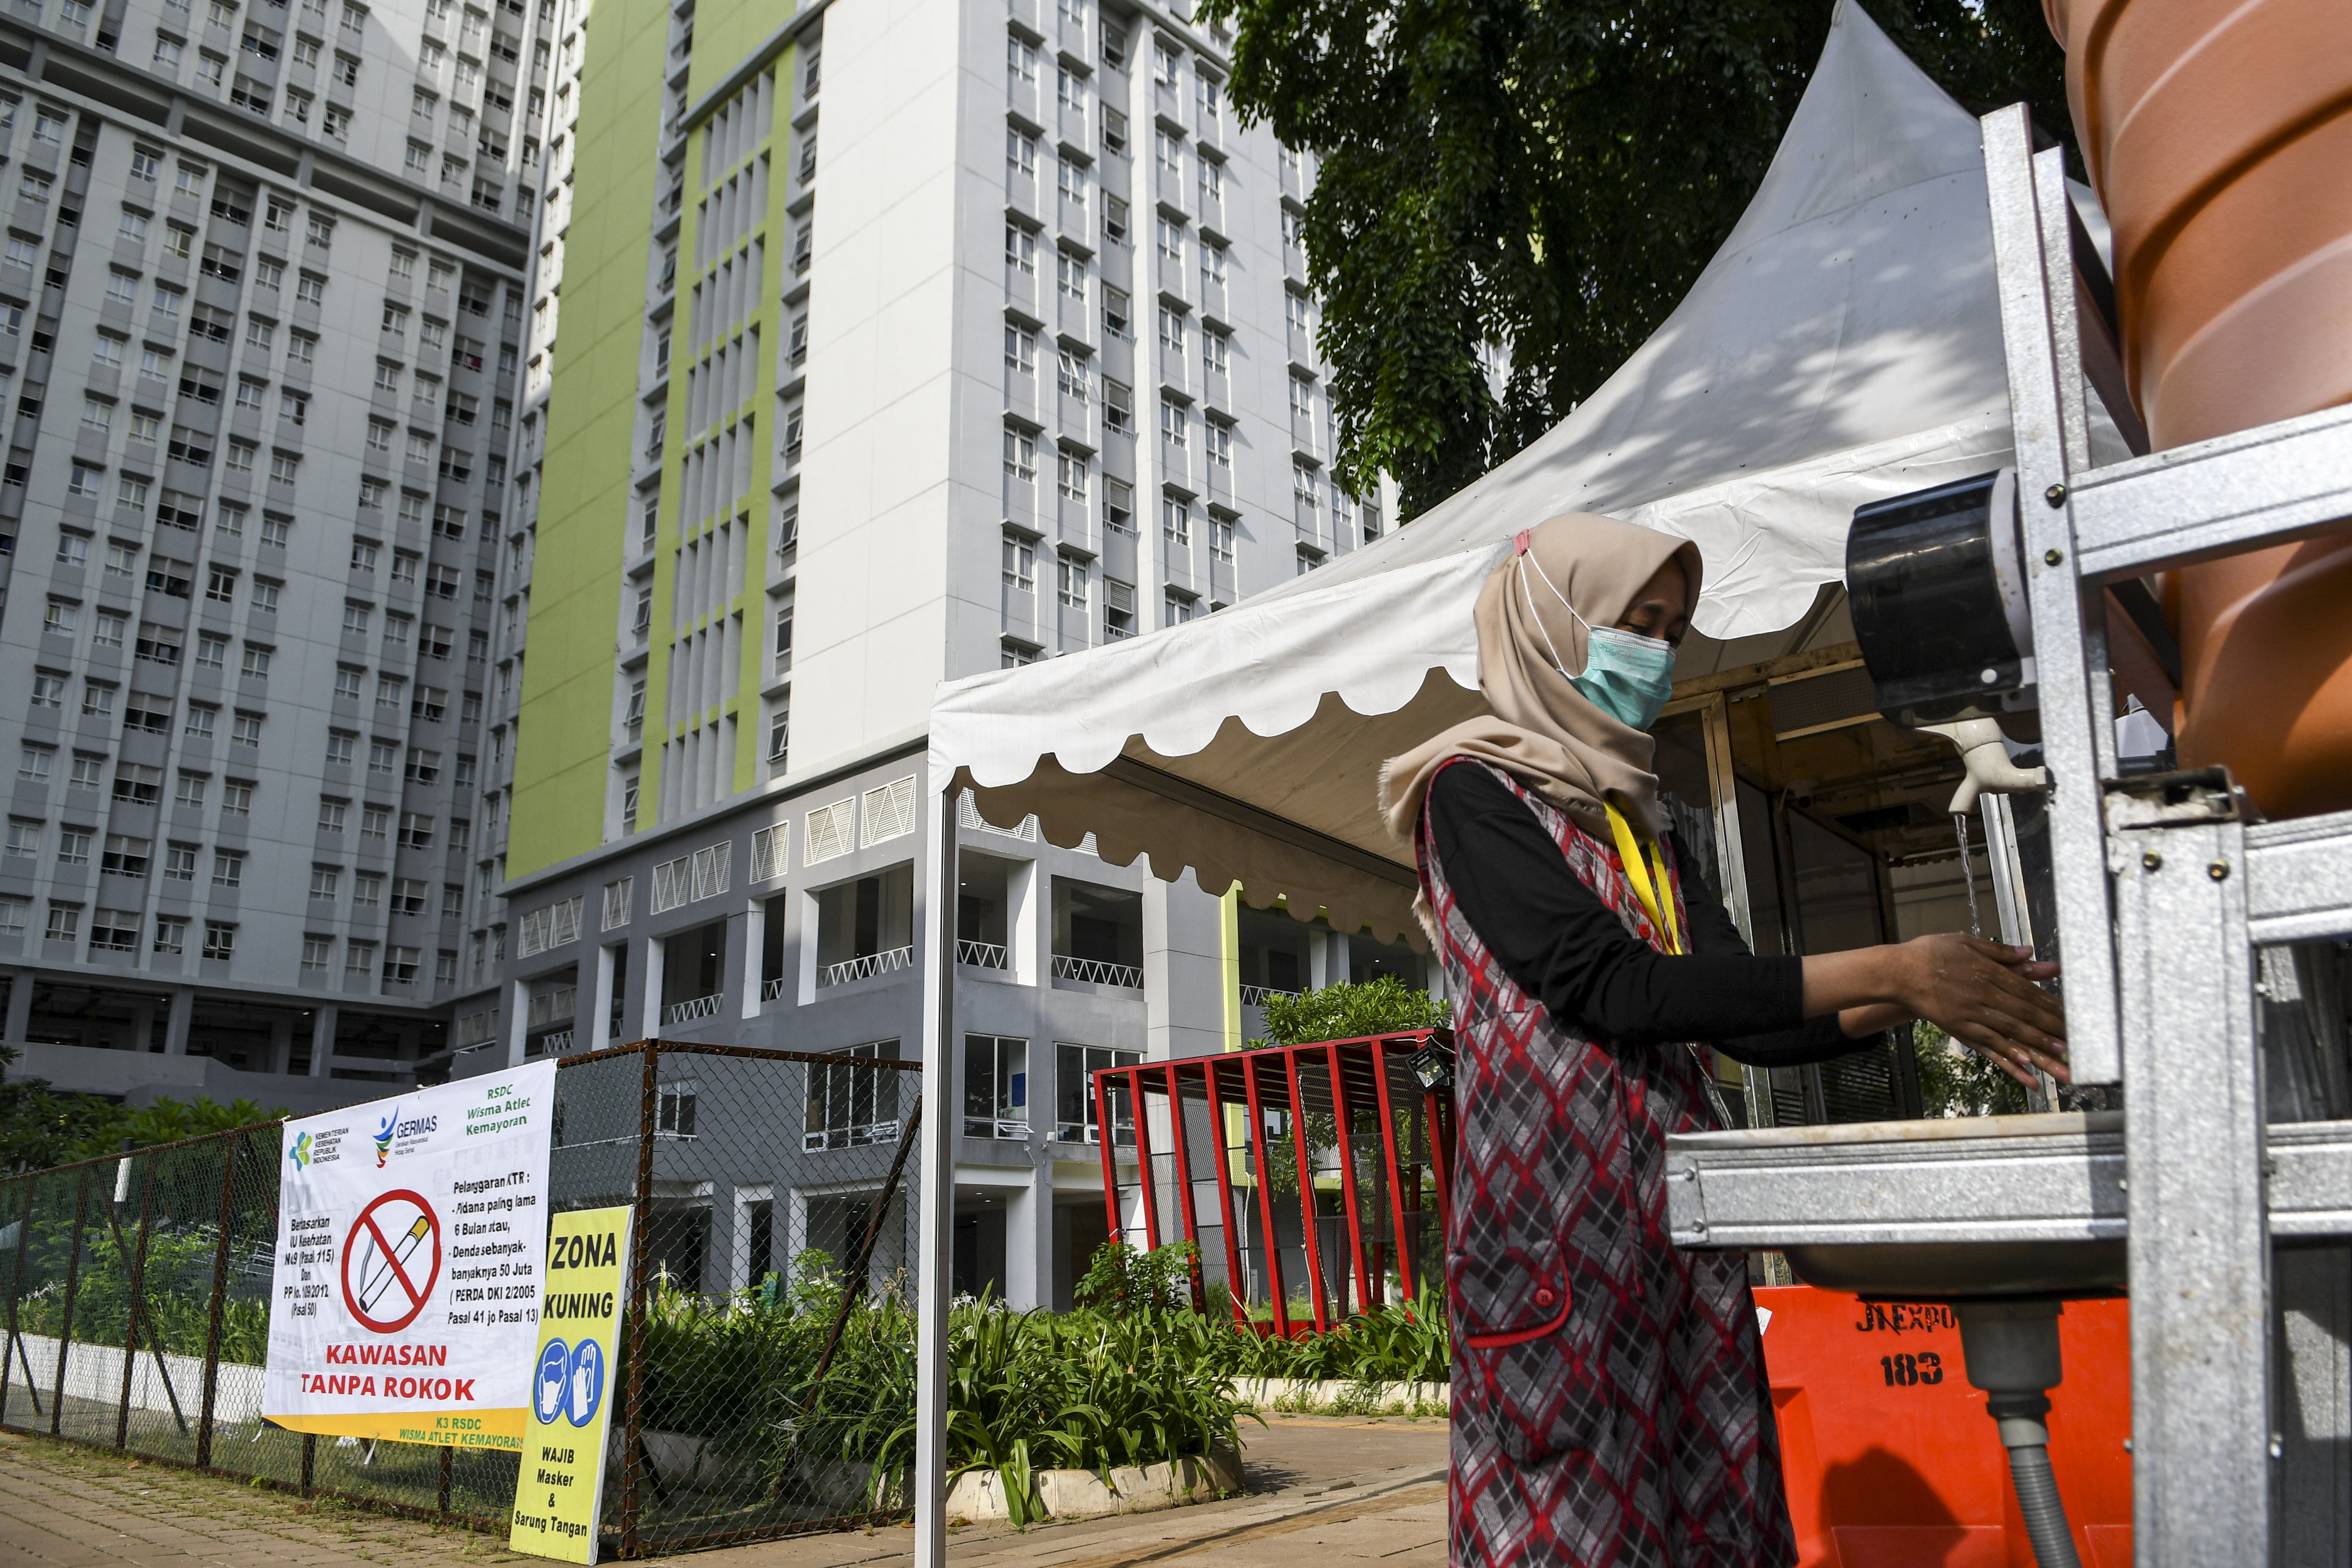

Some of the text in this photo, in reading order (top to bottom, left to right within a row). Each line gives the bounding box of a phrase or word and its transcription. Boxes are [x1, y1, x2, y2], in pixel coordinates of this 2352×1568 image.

[487, 1084, 513, 1100] RSDC
[468, 1097, 530, 1119] Wisma Atlet
[316, 1127, 349, 1140] KEMENTERIAN
[397, 1116, 437, 1138] GERMAS
[466, 1116, 527, 1135] Kemayoran
[313, 1146, 337, 1156] REPUBLIK
[315, 1137, 341, 1147] KESEHATAN
[313, 1154, 340, 1164] INDONESIA
[515, 1195, 536, 1207] lama
[455, 1224, 460, 1236] 6
[462, 1222, 487, 1235] Bulan
[317, 1249, 334, 1266] 115)
[453, 1244, 480, 1258] Denda
[551, 1232, 616, 1269] ZONA
[452, 1263, 532, 1282] banyaknya 50 Juta
[284, 1286, 293, 1299] PP
[456, 1288, 484, 1301] PERDA
[488, 1287, 503, 1300] DKI
[505, 1285, 535, 1299] 2/2005
[543, 1292, 613, 1319] KUNING
[448, 1308, 538, 1326] Pasal 41 jo Pasal 13)
[327, 1345, 447, 1366] KAWASAN
[1881, 1352, 1943, 1386] 183
[301, 1374, 476, 1401] TANPA ROKOK
[436, 1417, 482, 1430] K3 RSDC
[399, 1429, 523, 1449] WISMA ATLET KEMAYORAN
[542, 1446, 574, 1464] WAJIB
[536, 1468, 574, 1487] Masker
[548, 1493, 555, 1508] &
[515, 1510, 587, 1538] Sarung Tangan
